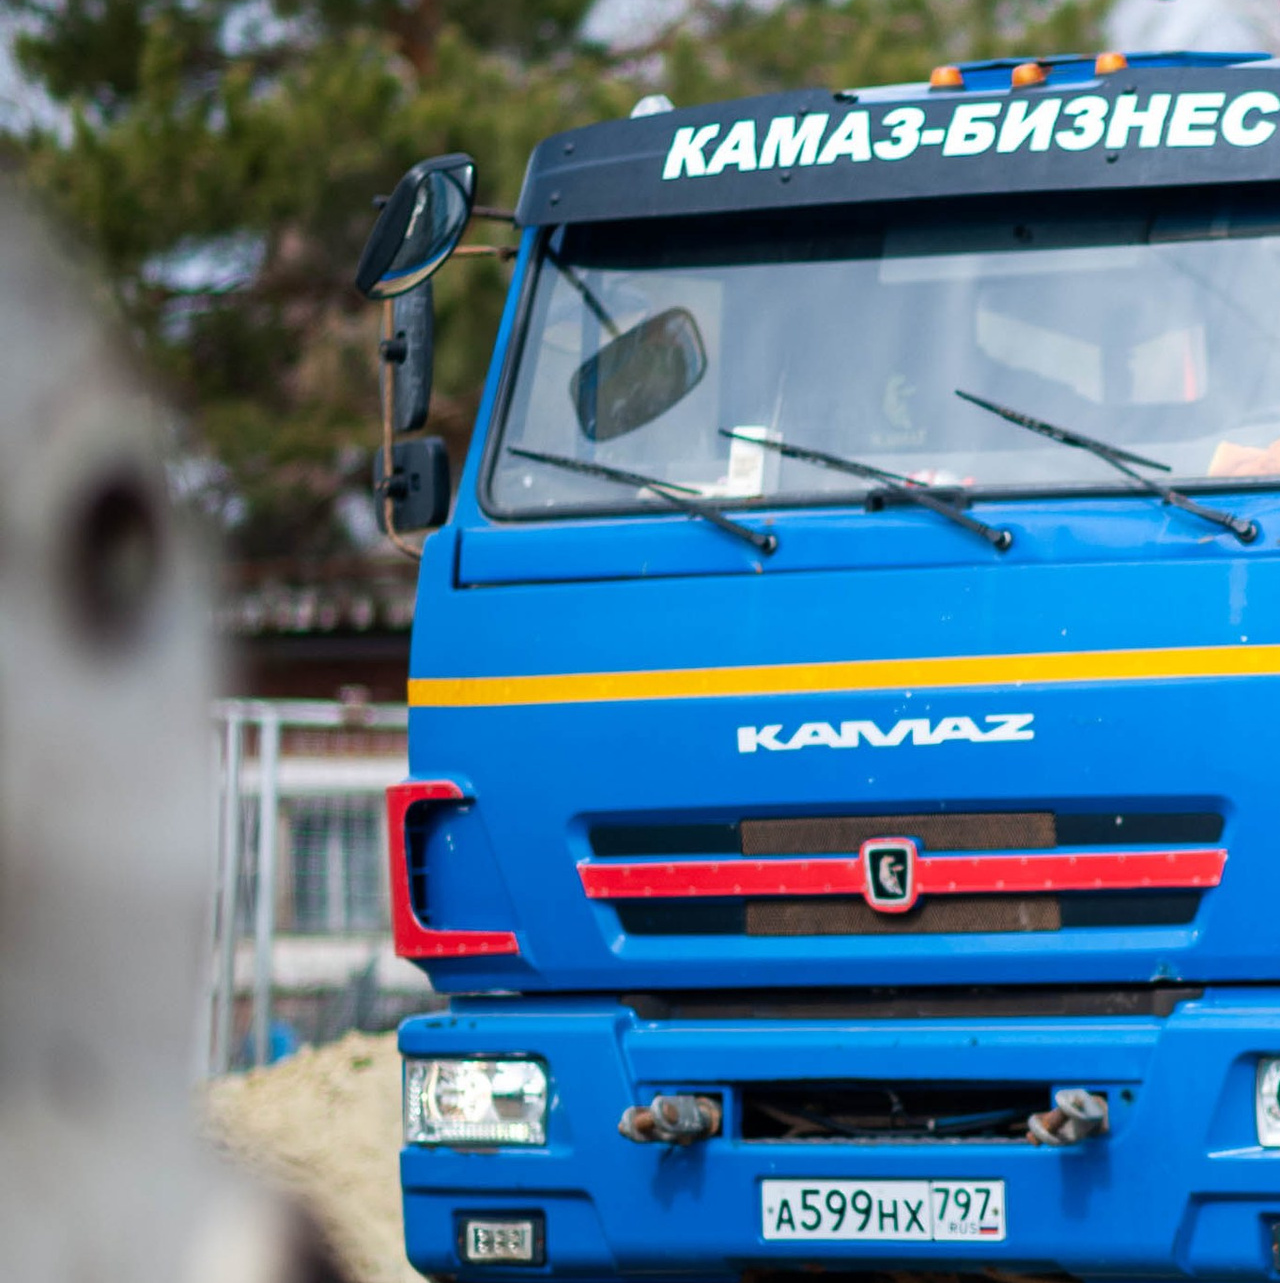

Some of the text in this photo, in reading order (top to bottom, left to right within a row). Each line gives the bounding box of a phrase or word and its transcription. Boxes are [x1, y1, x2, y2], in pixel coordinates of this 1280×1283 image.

[737, 713, 1035, 753] KAMAZ
[776, 1188, 991, 1232] А599НХ 797
[950, 1222, 978, 1234] RUS
